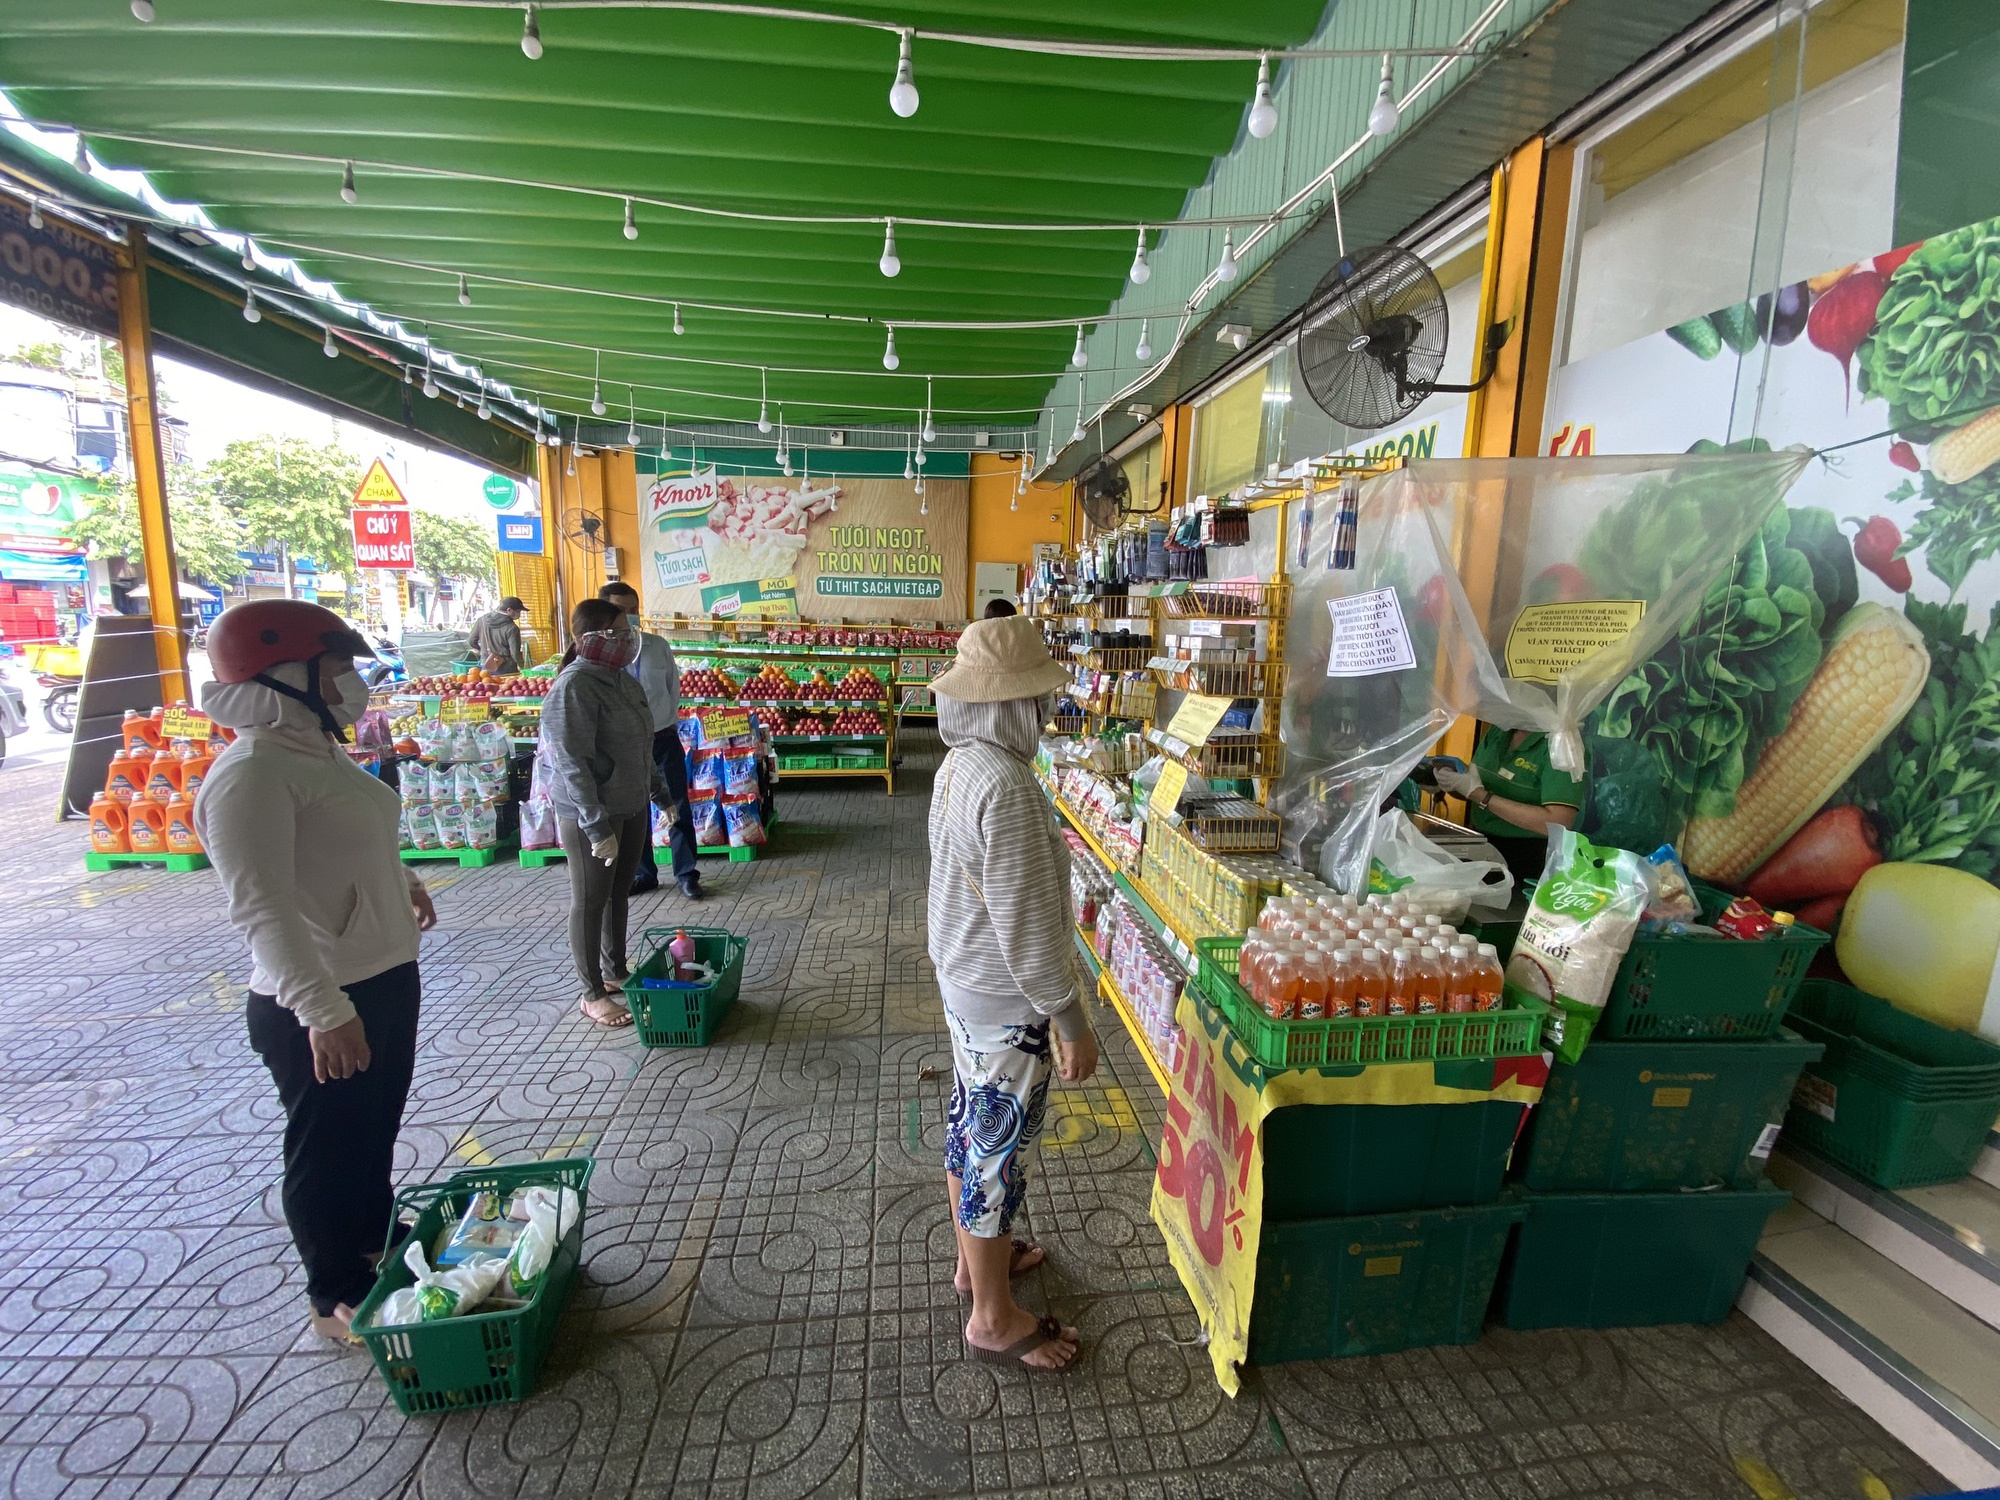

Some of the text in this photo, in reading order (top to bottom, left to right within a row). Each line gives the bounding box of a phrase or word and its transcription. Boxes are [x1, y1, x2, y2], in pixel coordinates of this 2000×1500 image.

[650, 483, 713, 511] Knorr
[366, 514, 398, 534] CHÚ Ý
[829, 524, 930, 553] TƯƠI NGỌT,
[357, 541, 411, 562] QUAN SÁT
[660, 556, 704, 576] TƯƠI SẠCH
[816, 549, 942, 577] TRÒN VỊ NGON
[767, 579, 788, 589] MỚI
[819, 578, 940, 596] TỪ THỊT SẠCH VIETGAP
[760, 592, 771, 600] Hạt
[712, 599, 740, 615] Knorr
[1374, 627, 1399, 638] GIAN
[1527, 637, 1538, 645] VÌ
[1550, 638, 1575, 646] TOÀN
[1553, 646, 1585, 654] KHÁCH
[1350, 658, 1375, 667] CHÍNH
[1376, 655, 1396, 664] PHỦ
[1537, 658, 1569, 666] THÀNH
[1552, 881, 1595, 911] Ngon
